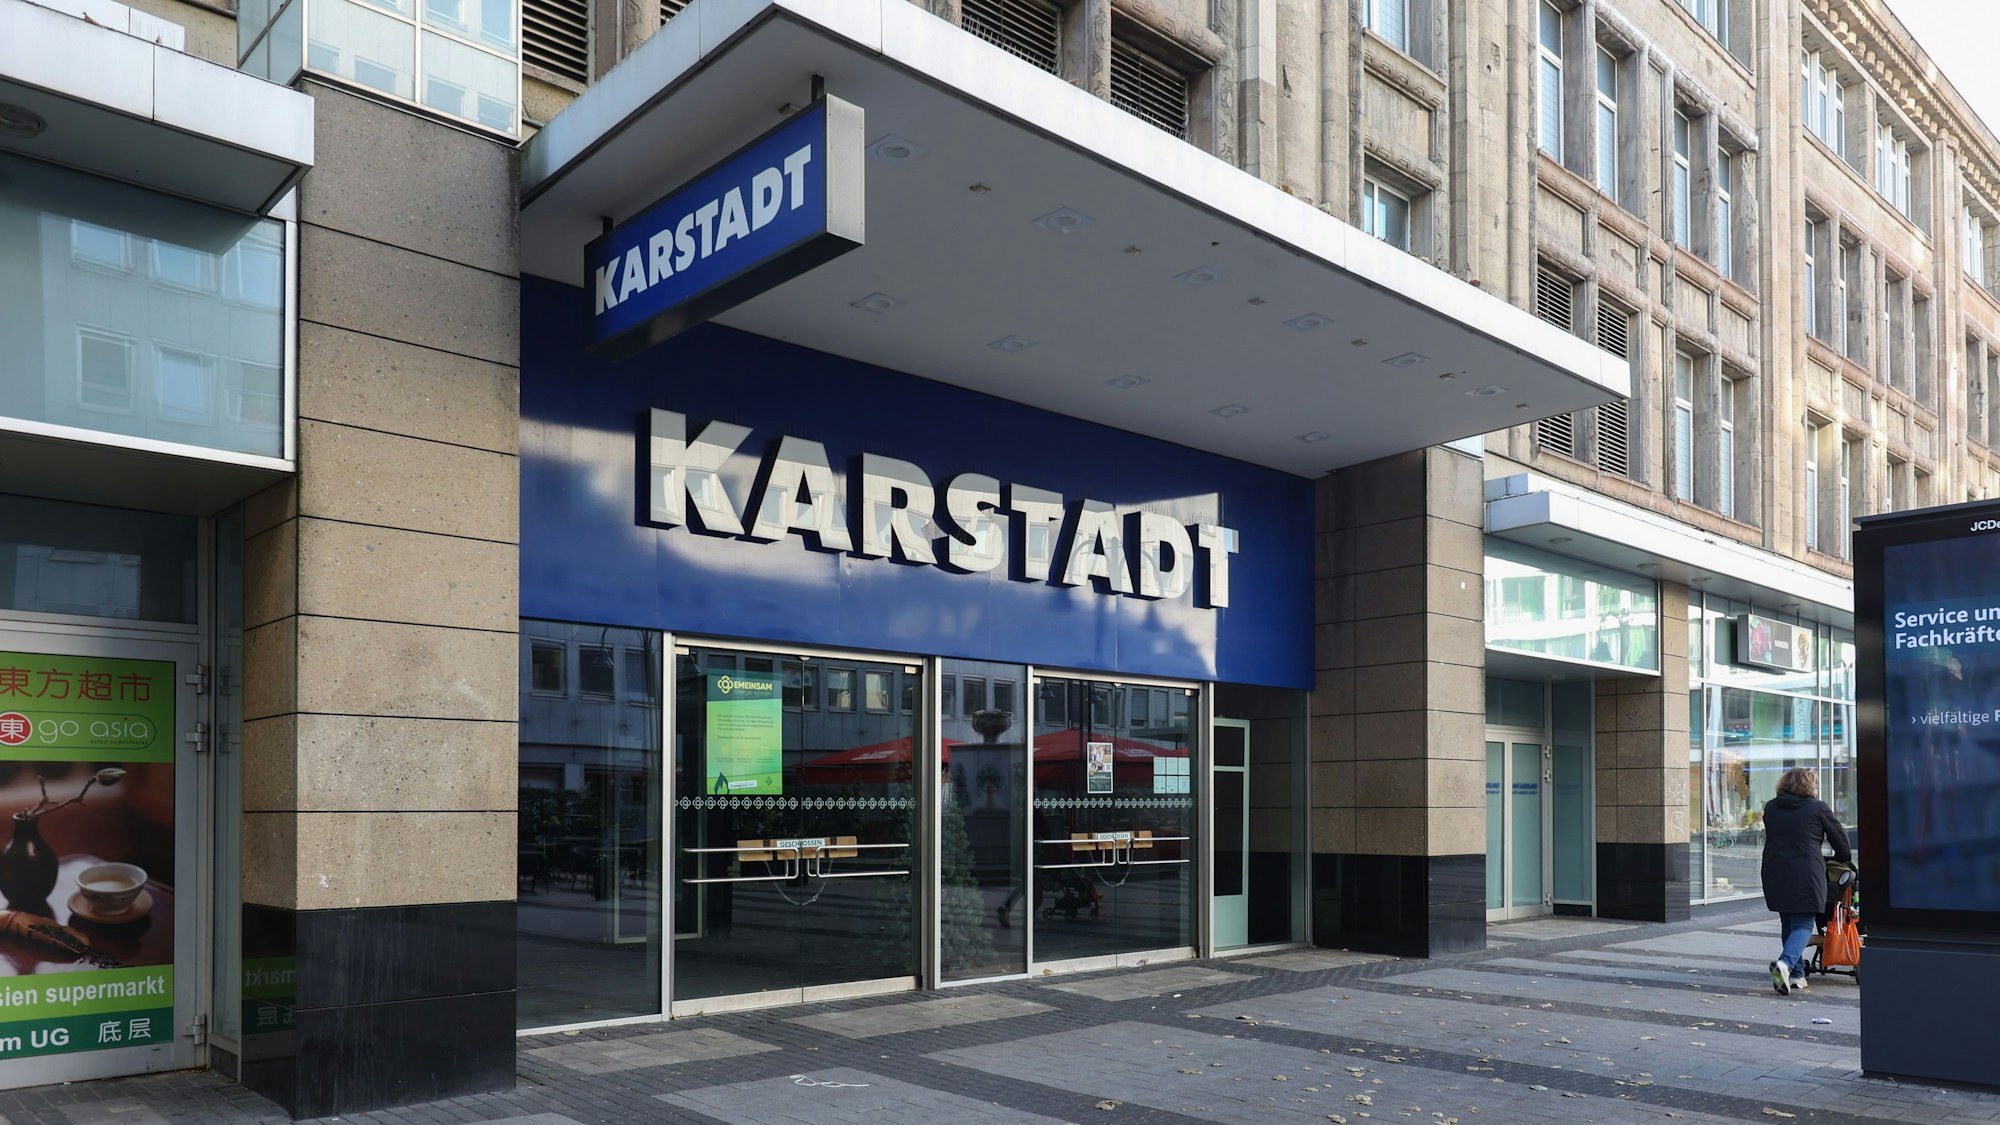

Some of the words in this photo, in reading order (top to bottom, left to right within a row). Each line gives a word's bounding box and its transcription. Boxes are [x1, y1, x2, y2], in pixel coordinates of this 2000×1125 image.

[596, 143, 811, 316] KARSTADT
[649, 406, 1239, 608] KARSTADT
[1894, 607, 1968, 628] Service
[1974, 606, 2000, 621] un
[0, 667, 152, 702] 東方超市
[0, 718, 26, 739] 東
[38, 719, 79, 744] go
[90, 716, 148, 738] asia
[1920, 709, 1990, 725] vielfältige
[46, 975, 165, 1006] supermarkt
[31, 1027, 70, 1048] UG
[98, 1017, 152, 1043] 底层
